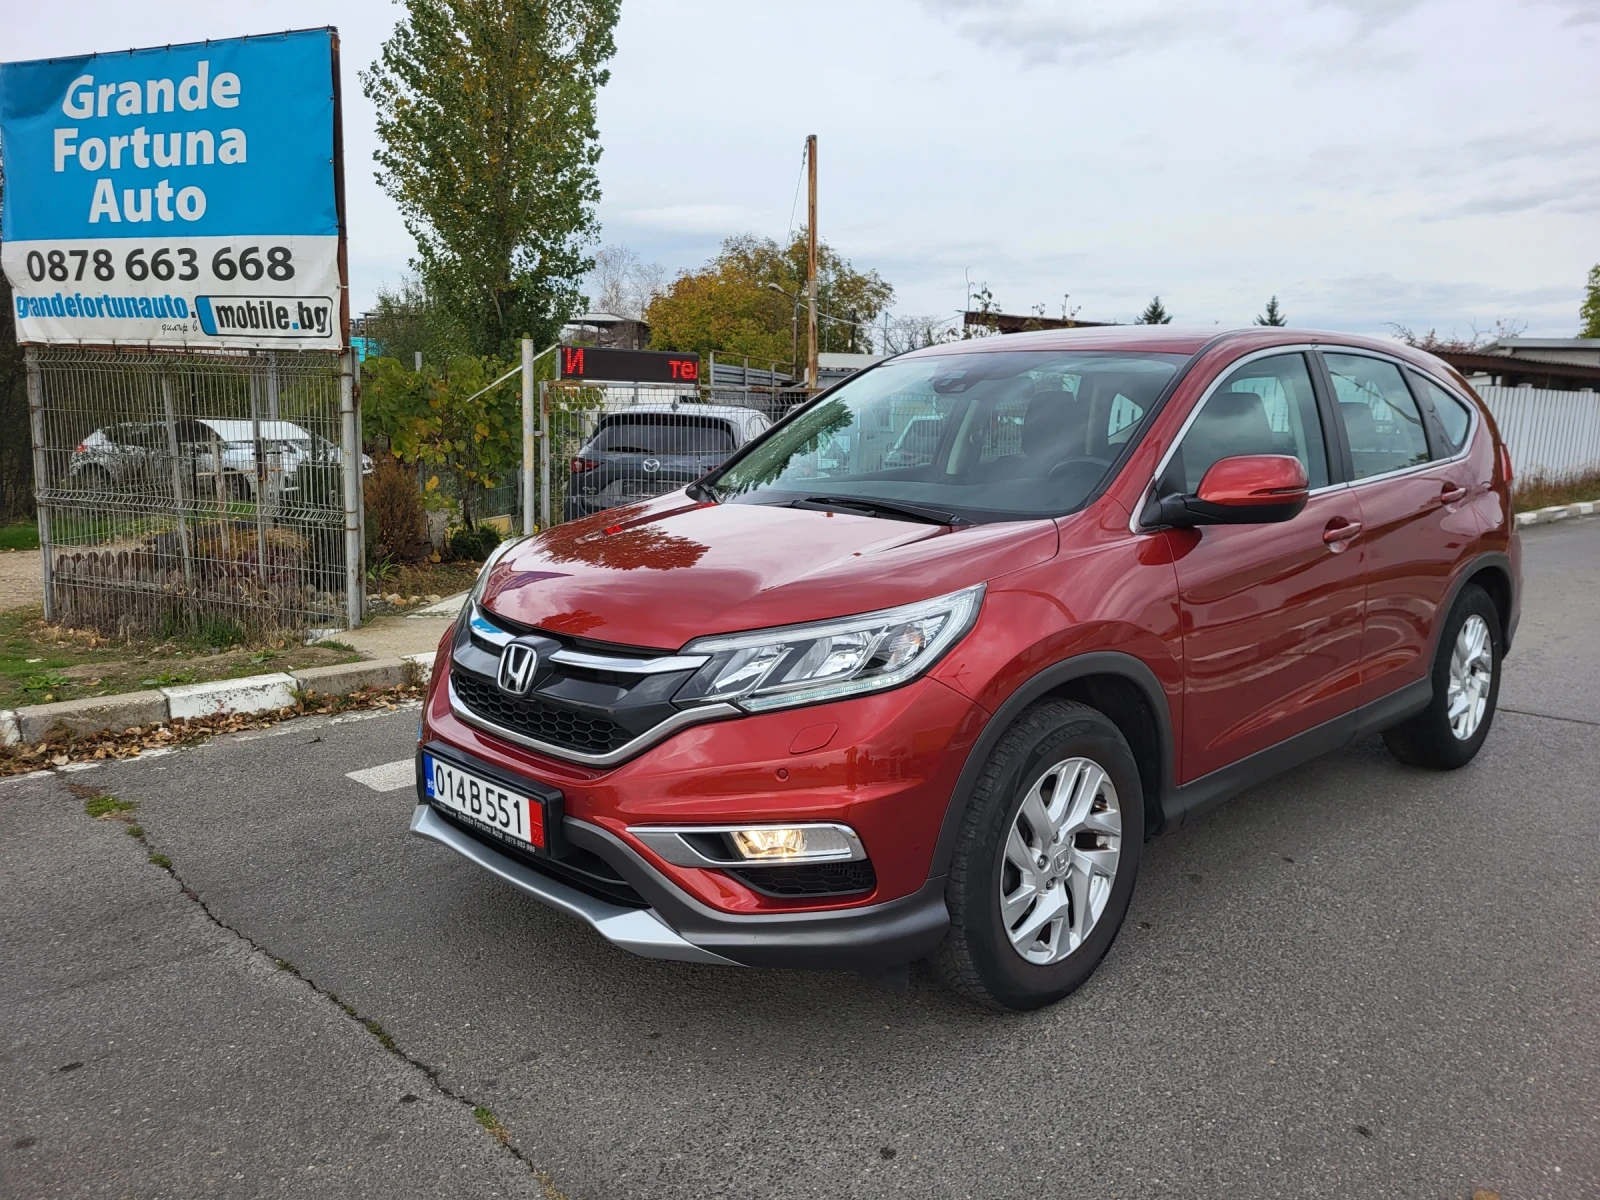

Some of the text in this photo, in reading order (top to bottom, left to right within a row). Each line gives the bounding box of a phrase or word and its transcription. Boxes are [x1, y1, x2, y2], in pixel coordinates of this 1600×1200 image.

[62, 60, 241, 119] Grande
[54, 126, 247, 172] Fortuna
[88, 178, 207, 223] Auto
[27, 246, 295, 282] 0878 663 668
[215, 300, 328, 333] mobile.bg
[435, 764, 522, 834] 014B551
[457, 811, 474, 825] Grande
